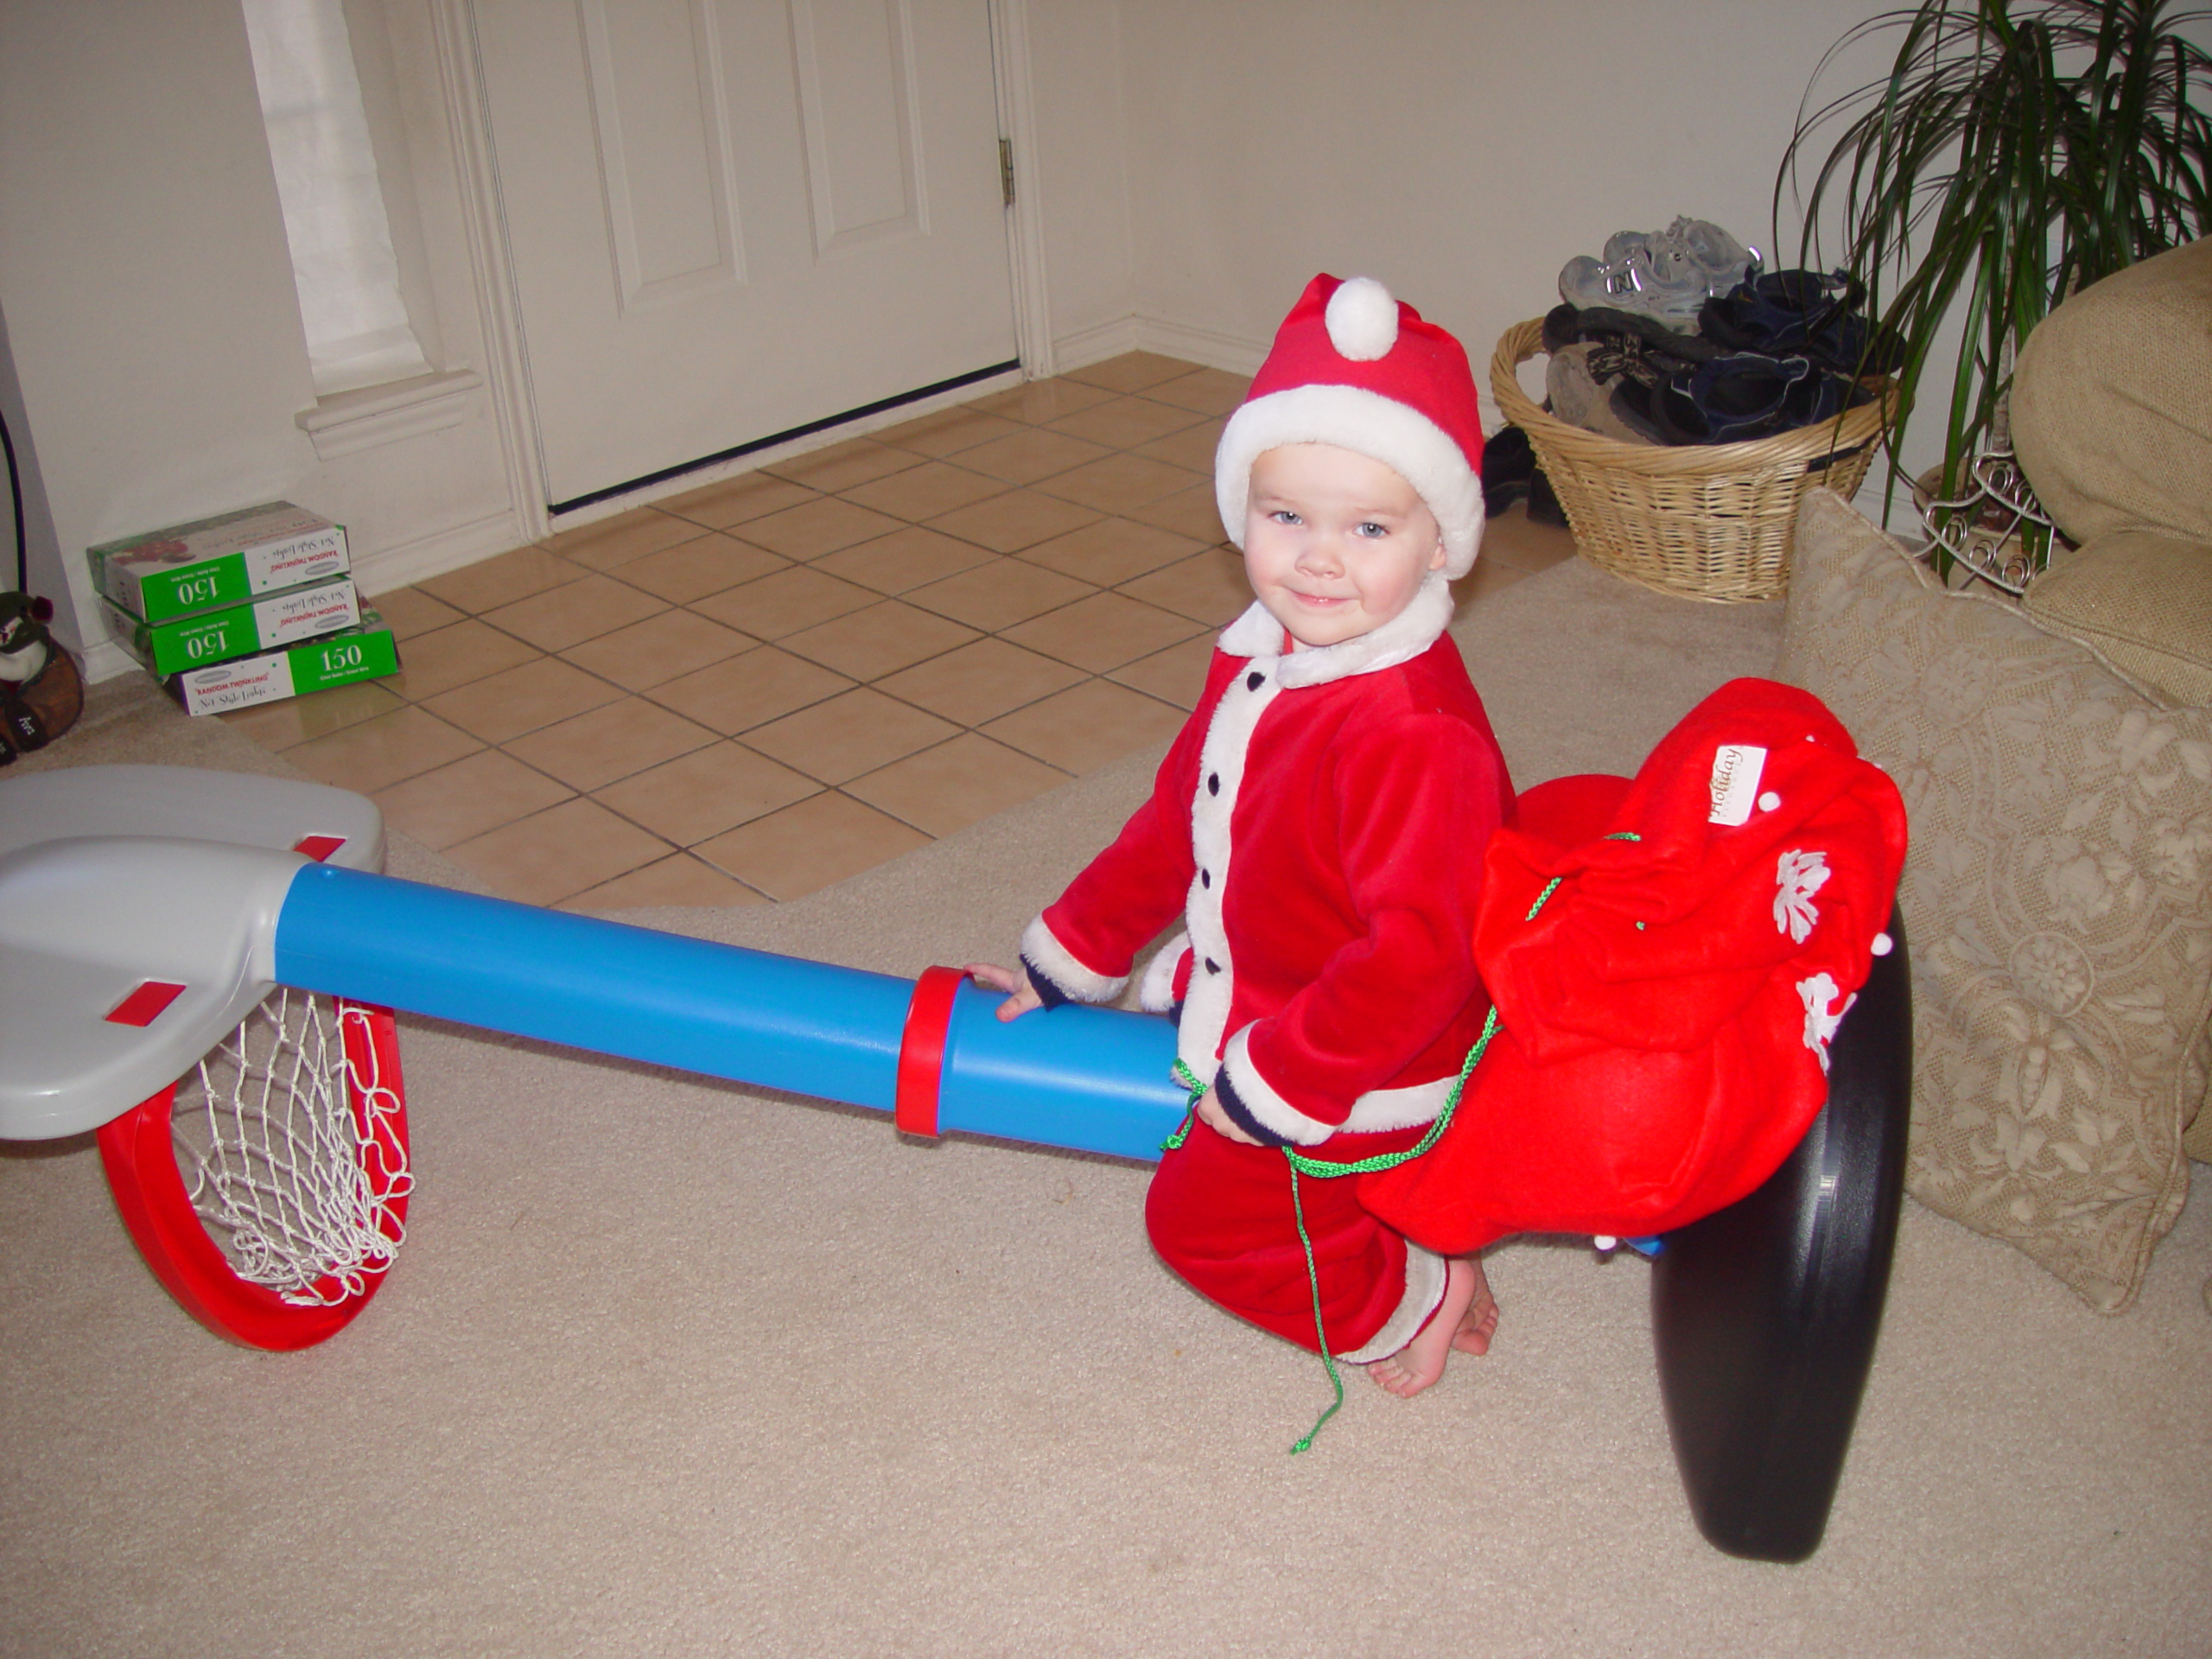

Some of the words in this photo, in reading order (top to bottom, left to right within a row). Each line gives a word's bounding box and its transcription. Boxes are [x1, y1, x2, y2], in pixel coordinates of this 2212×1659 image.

[1613, 270, 1634, 294] N
[178, 576, 219, 605] 150
[188, 631, 229, 659] 150
[321, 645, 362, 671] 150
[1710, 748, 1744, 817] Holiday
